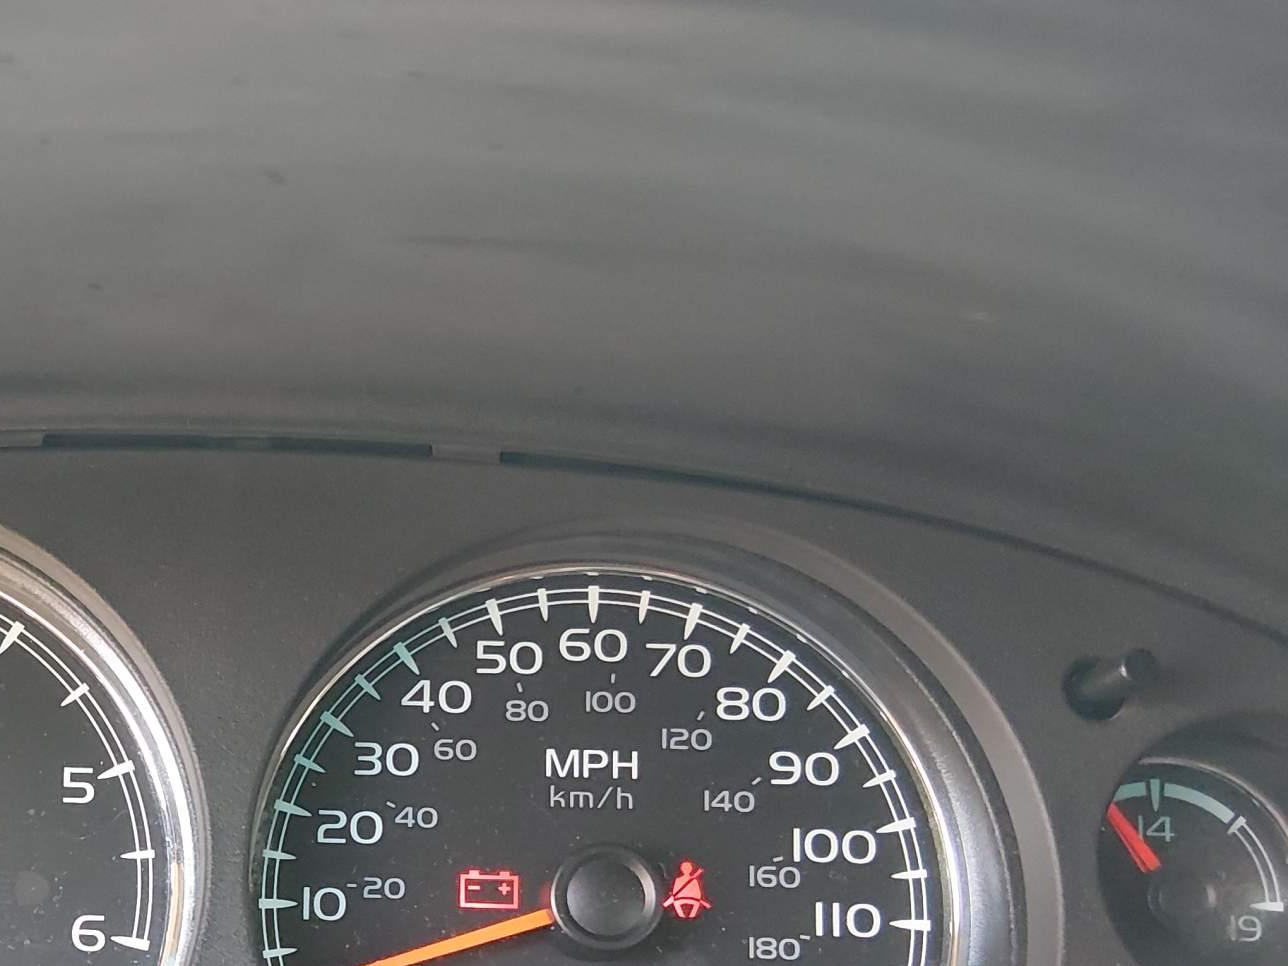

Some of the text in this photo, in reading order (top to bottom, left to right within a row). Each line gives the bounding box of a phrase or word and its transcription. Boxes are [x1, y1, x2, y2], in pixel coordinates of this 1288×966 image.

[475, 641, 543, 676] 50
[559, 629, 628, 663] 60
[646, 644, 712, 678] 70
[401, 680, 472, 714] 40
[505, 699, 549, 722] 80
[585, 691, 635, 713] 100
[716, 687, 786, 721] 80
[434, 738, 478, 761] 60
[661, 728, 712, 751] 120
[354, 742, 420, 776] 30
[544, 749, 639, 779] MPH
[768, 751, 839, 786] 90
[63, 767, 96, 804] 5
[550, 787, 634, 810] km/h
[703, 790, 755, 813] 140
[316, 810, 383, 845] 20
[394, 807, 438, 830] 40
[1137, 815, 1175, 842] 14
[792, 829, 876, 864] 100
[363, 877, 406, 899] 20
[748, 865, 800, 888] 160
[301, 887, 347, 921] 10
[71, 915, 106, 952] 6
[815, 903, 880, 938] 110
[1229, 915, 1263, 942] 19
[748, 937, 800, 960] 180
